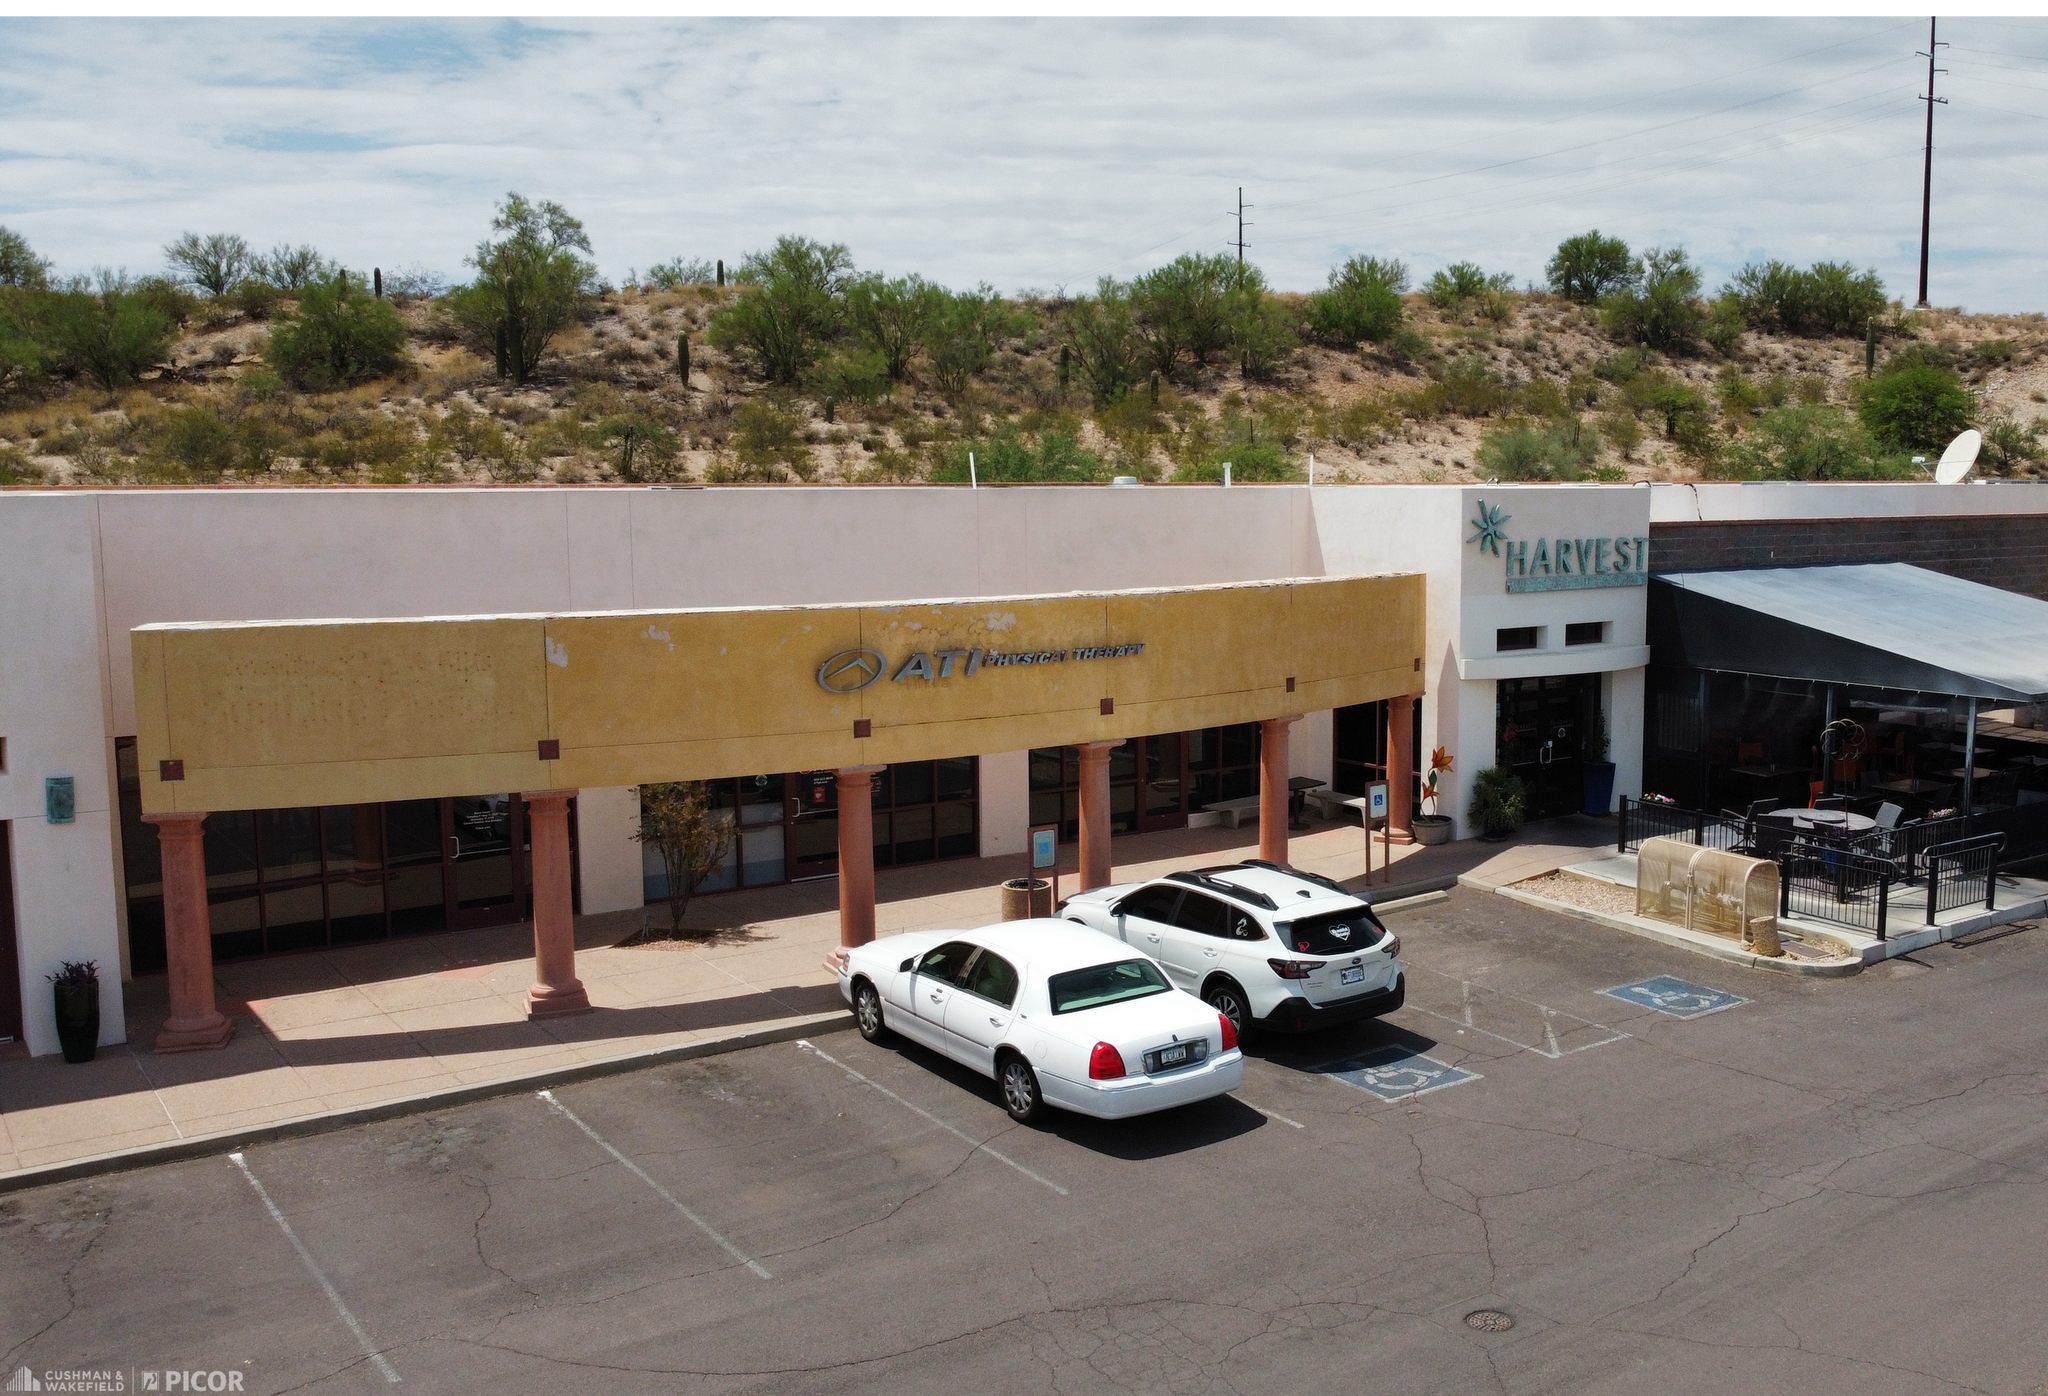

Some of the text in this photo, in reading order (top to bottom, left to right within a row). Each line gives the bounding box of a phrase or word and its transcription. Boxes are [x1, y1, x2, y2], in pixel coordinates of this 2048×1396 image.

[1506, 537, 1649, 576] HARVEST
[892, 648, 982, 682] ATI
[982, 644, 1146, 667] PHYSICAL THERAPY
